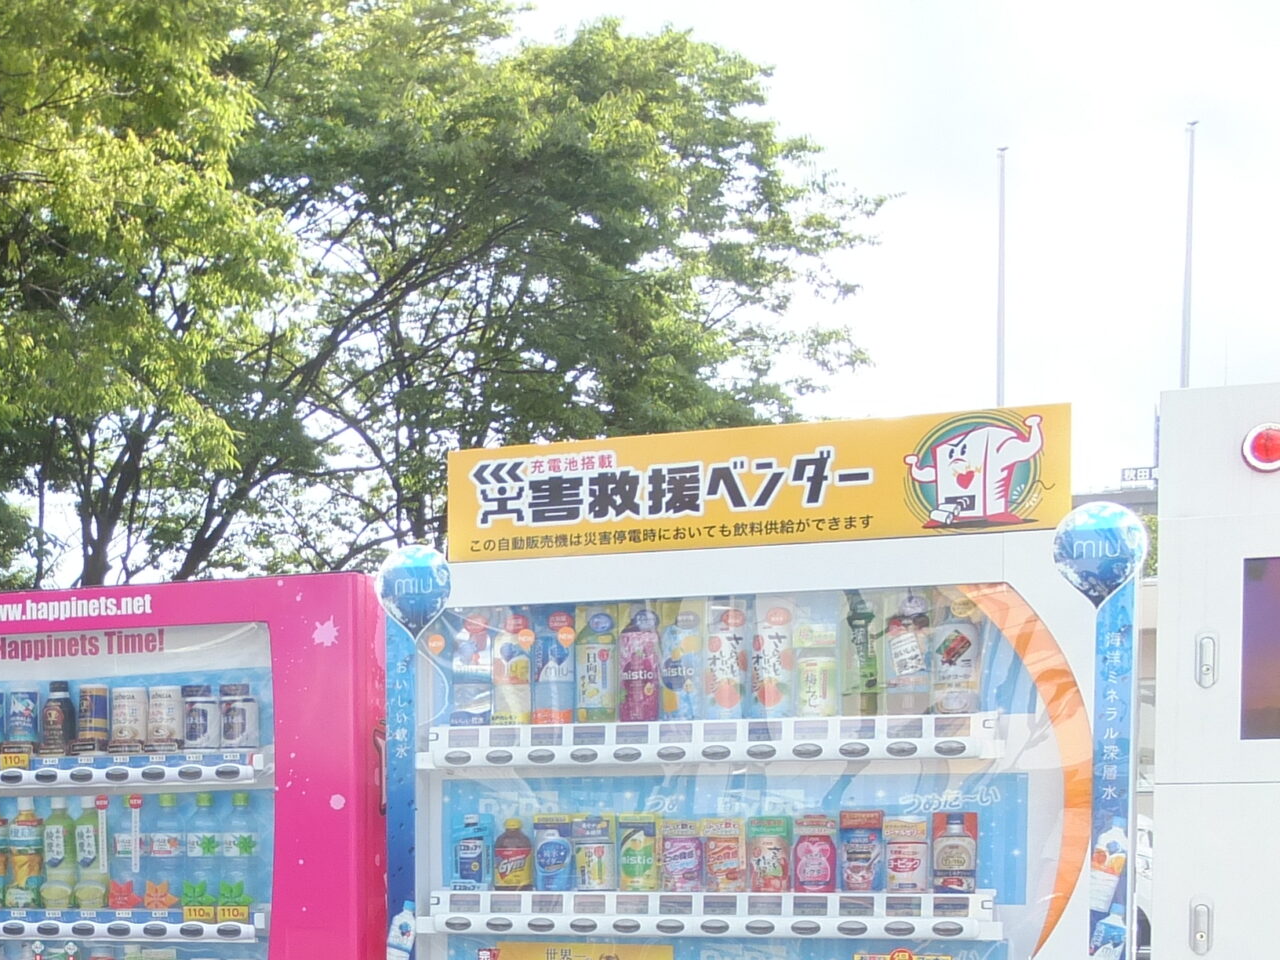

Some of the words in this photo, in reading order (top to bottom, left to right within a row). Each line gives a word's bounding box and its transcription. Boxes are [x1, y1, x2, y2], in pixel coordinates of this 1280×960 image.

[530, 453, 614, 473] 充電池搭載
[472, 447, 871, 526] 災害救援ベンダー
[469, 515, 874, 554] この自動販売機は災害停電時においても飲料供給ができます
[104, 628, 165, 656] Time!
[1102, 631, 1123, 801] 海洋ミネラル深層水
